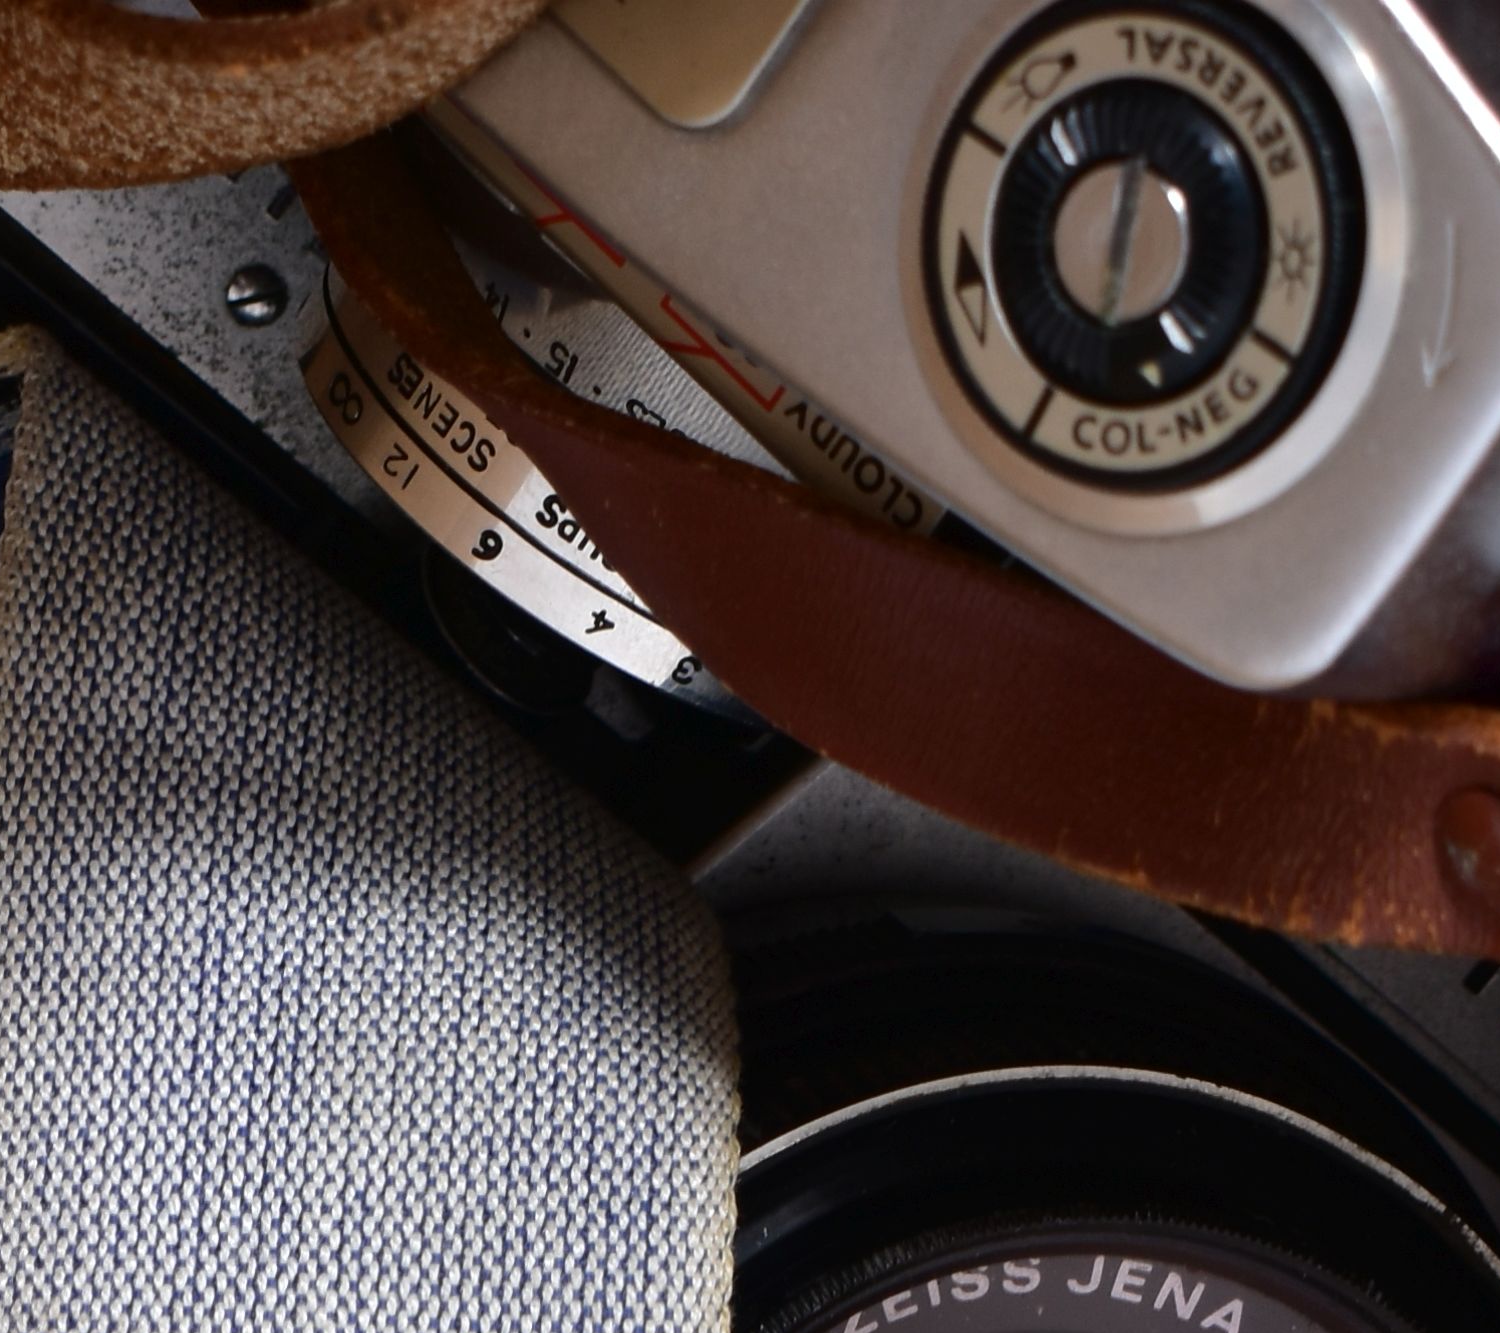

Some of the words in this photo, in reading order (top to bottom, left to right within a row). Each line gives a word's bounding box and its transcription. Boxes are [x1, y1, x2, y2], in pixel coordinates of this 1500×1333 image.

[1117, 27, 1299, 179] REVERSAL
[387, 352, 497, 473] SCENES
[545, 340, 579, 384] 15
[1071, 368, 1260, 456] COL-NEG
[381, 449, 421, 491] 12
[472, 530, 504, 562] 6
[586, 609, 616, 635] 4
[672, 654, 702, 687] 3
